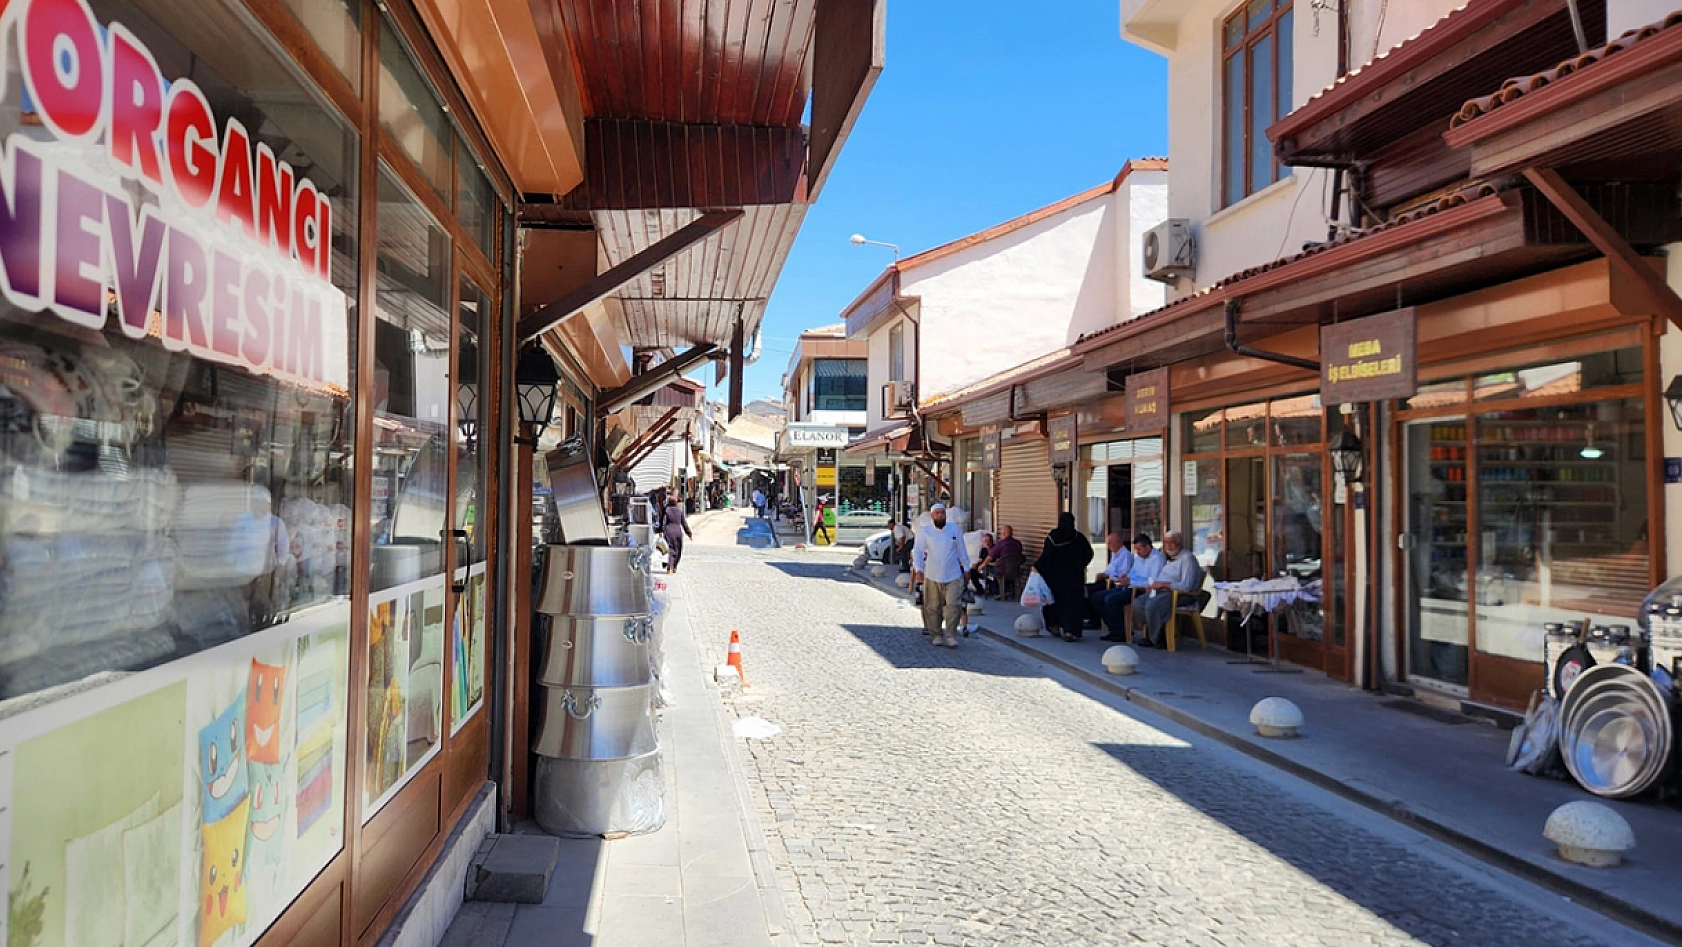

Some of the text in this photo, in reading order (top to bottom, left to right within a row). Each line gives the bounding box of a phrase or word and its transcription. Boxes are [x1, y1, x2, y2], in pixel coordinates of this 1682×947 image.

[0, 0, 330, 283] ORGANCI
[1347, 338, 1381, 359] MEBA
[793, 430, 844, 443] ELANOR
